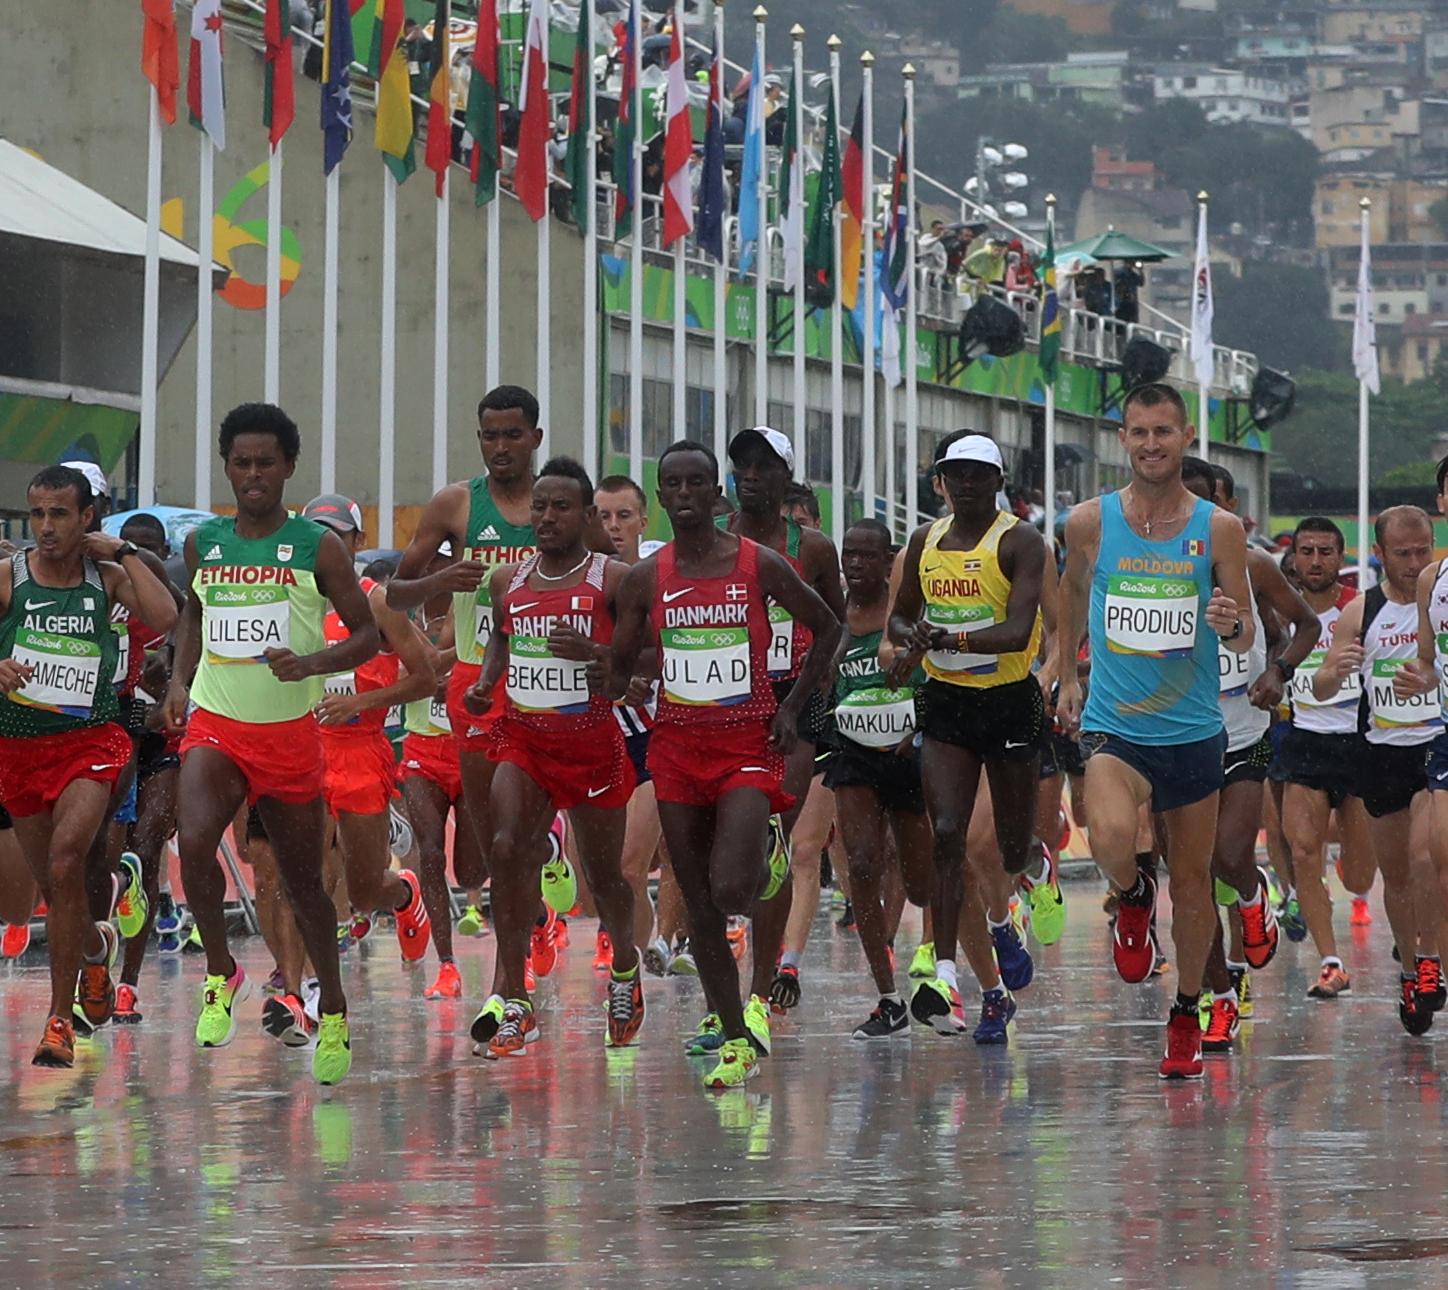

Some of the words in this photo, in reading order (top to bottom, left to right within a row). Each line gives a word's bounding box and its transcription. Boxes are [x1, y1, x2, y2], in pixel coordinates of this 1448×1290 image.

[201, 566, 298, 586] ETHIOPIA
[1118, 557, 1194, 574] MOLDOVA
[215, 591, 247, 601] Rio2016
[927, 579, 981, 598] UGANDA
[1119, 581, 1157, 594] Rio2016
[23, 614, 95, 634] ALGERIA
[666, 604, 749, 627] DANMARK
[1107, 606, 1194, 635] PRODIUS
[209, 619, 281, 643] LILESA
[507, 665, 587, 692] BEKELE
[663, 659, 747, 684] ULAD
[837, 713, 915, 735] MAKULA
